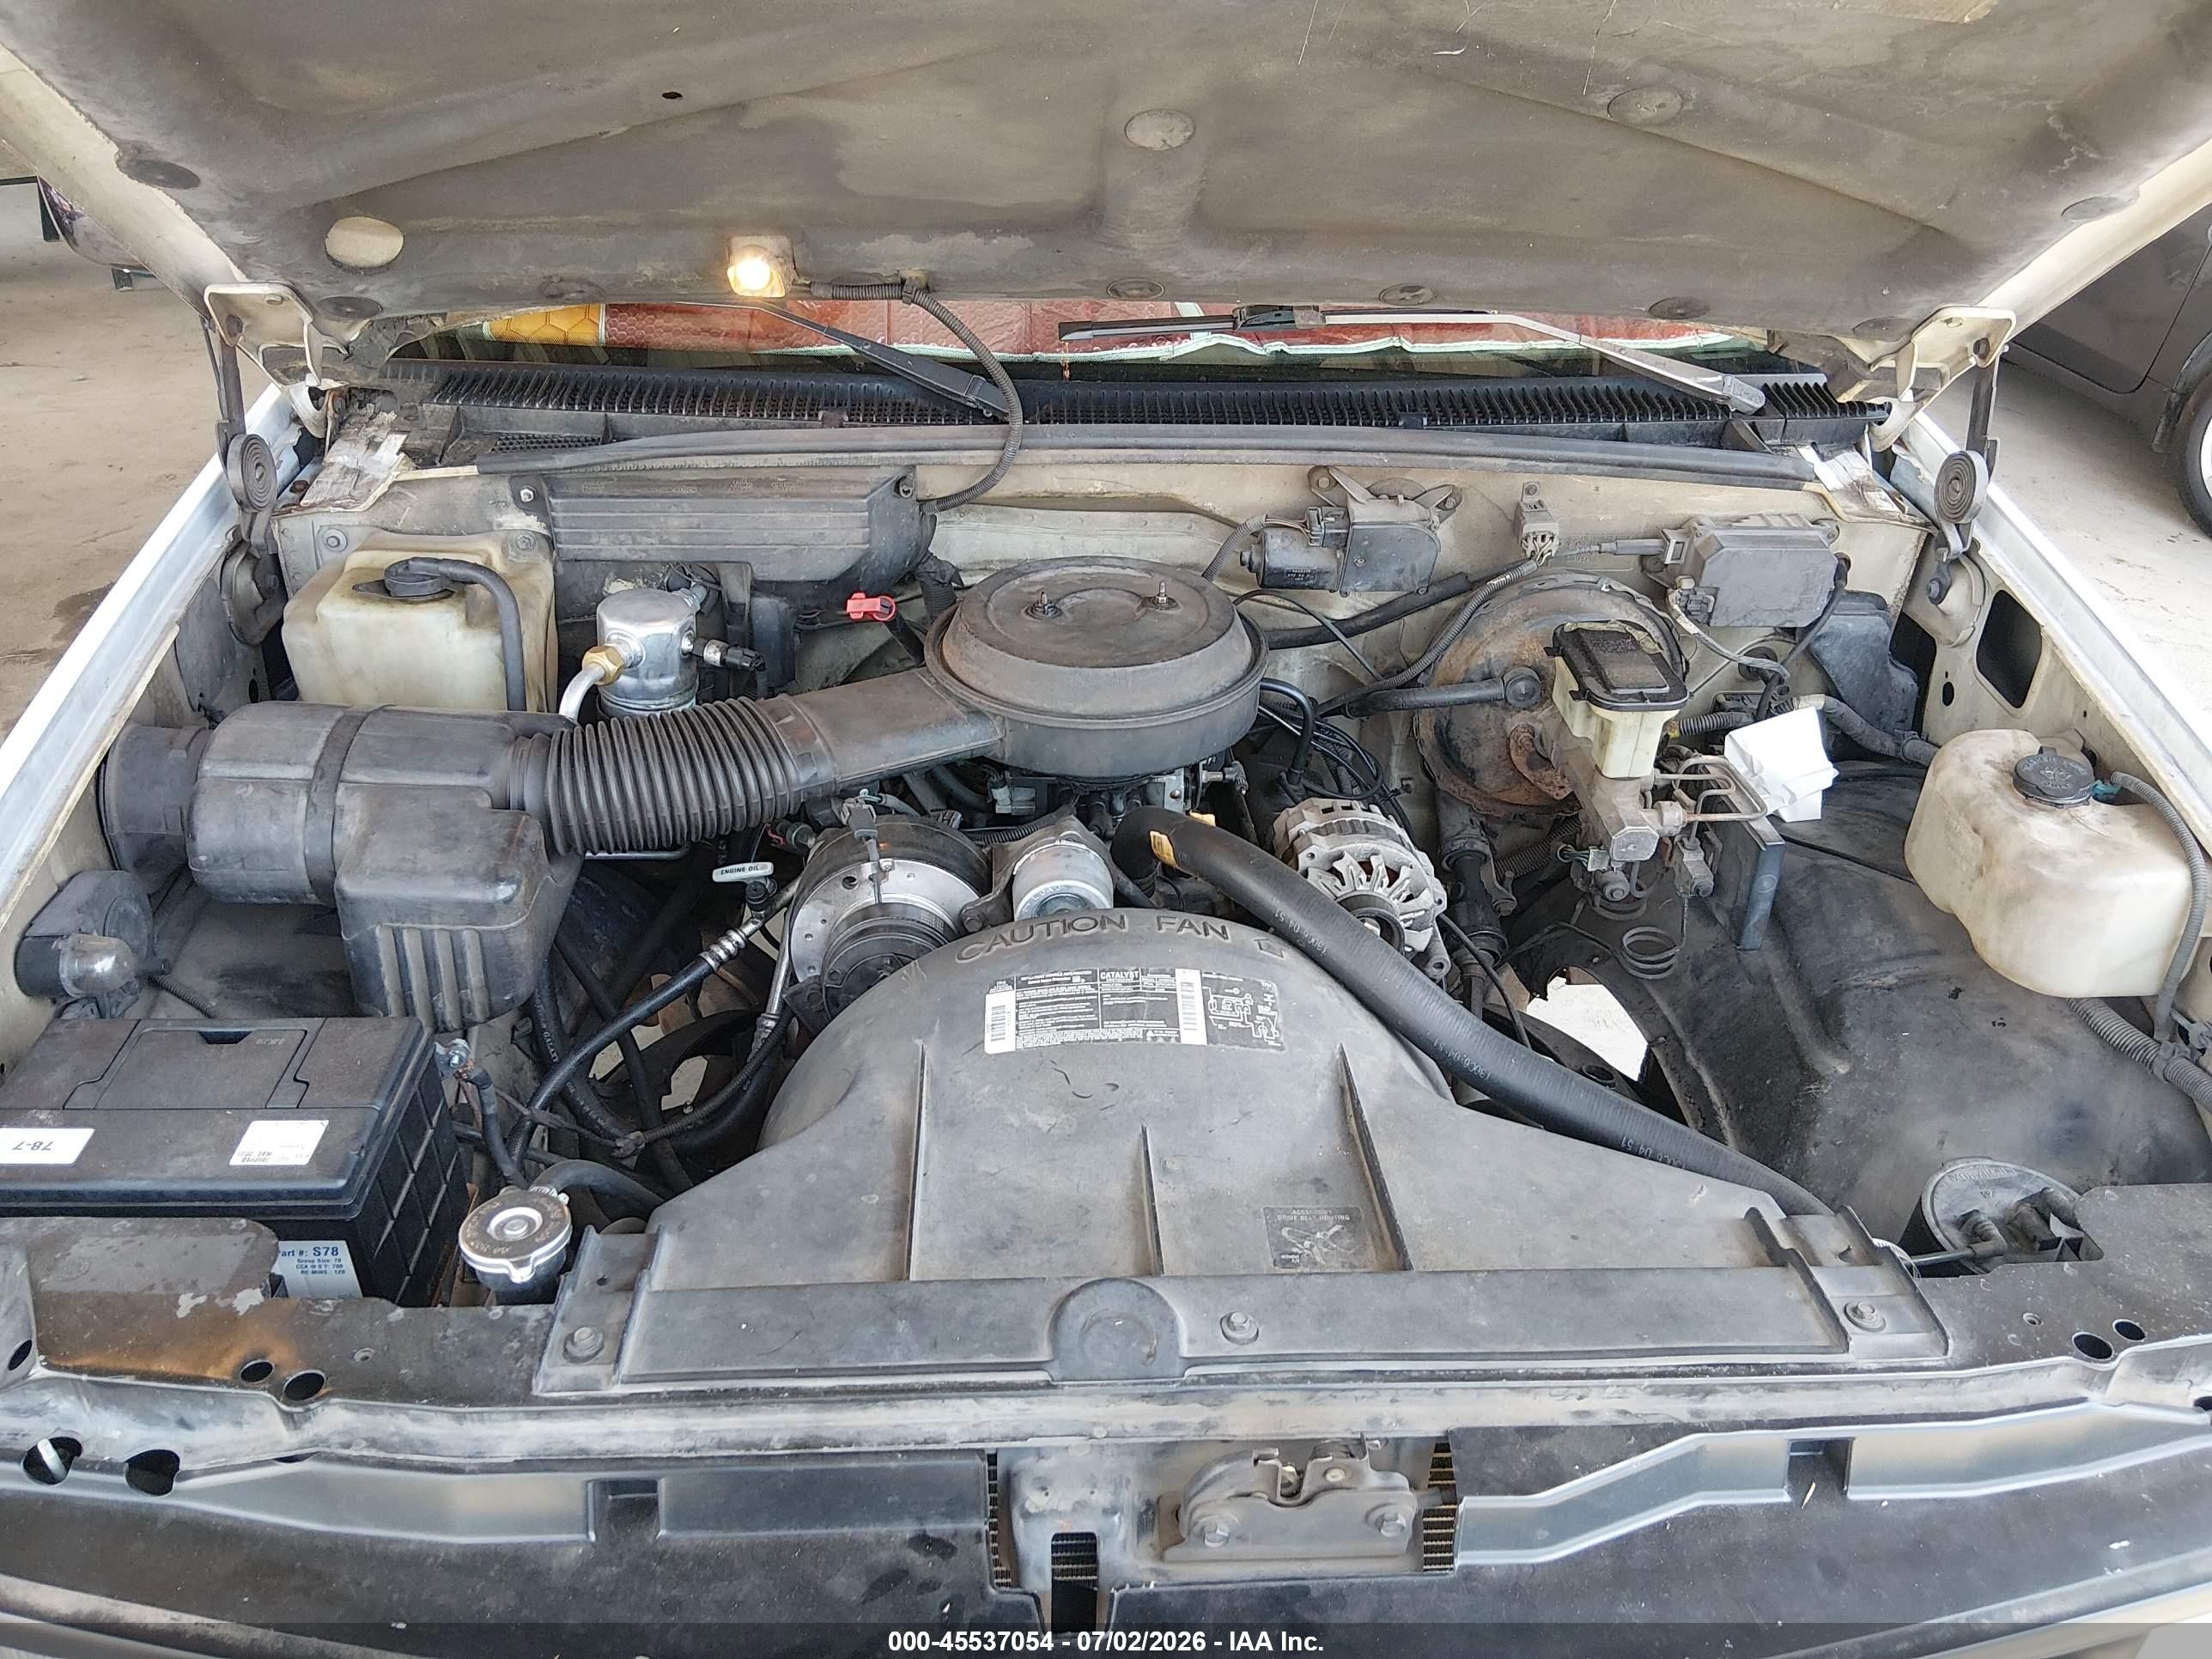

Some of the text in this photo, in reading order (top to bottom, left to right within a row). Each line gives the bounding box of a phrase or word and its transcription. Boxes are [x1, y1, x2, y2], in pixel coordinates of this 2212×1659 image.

[956, 913, 1127, 963] CAUTION
[1156, 915, 1231, 943] FAN
[1100, 970, 1139, 980] CATALYST
[11, 1140, 55, 1152] 78-7
[313, 1246, 339, 1256] S78
